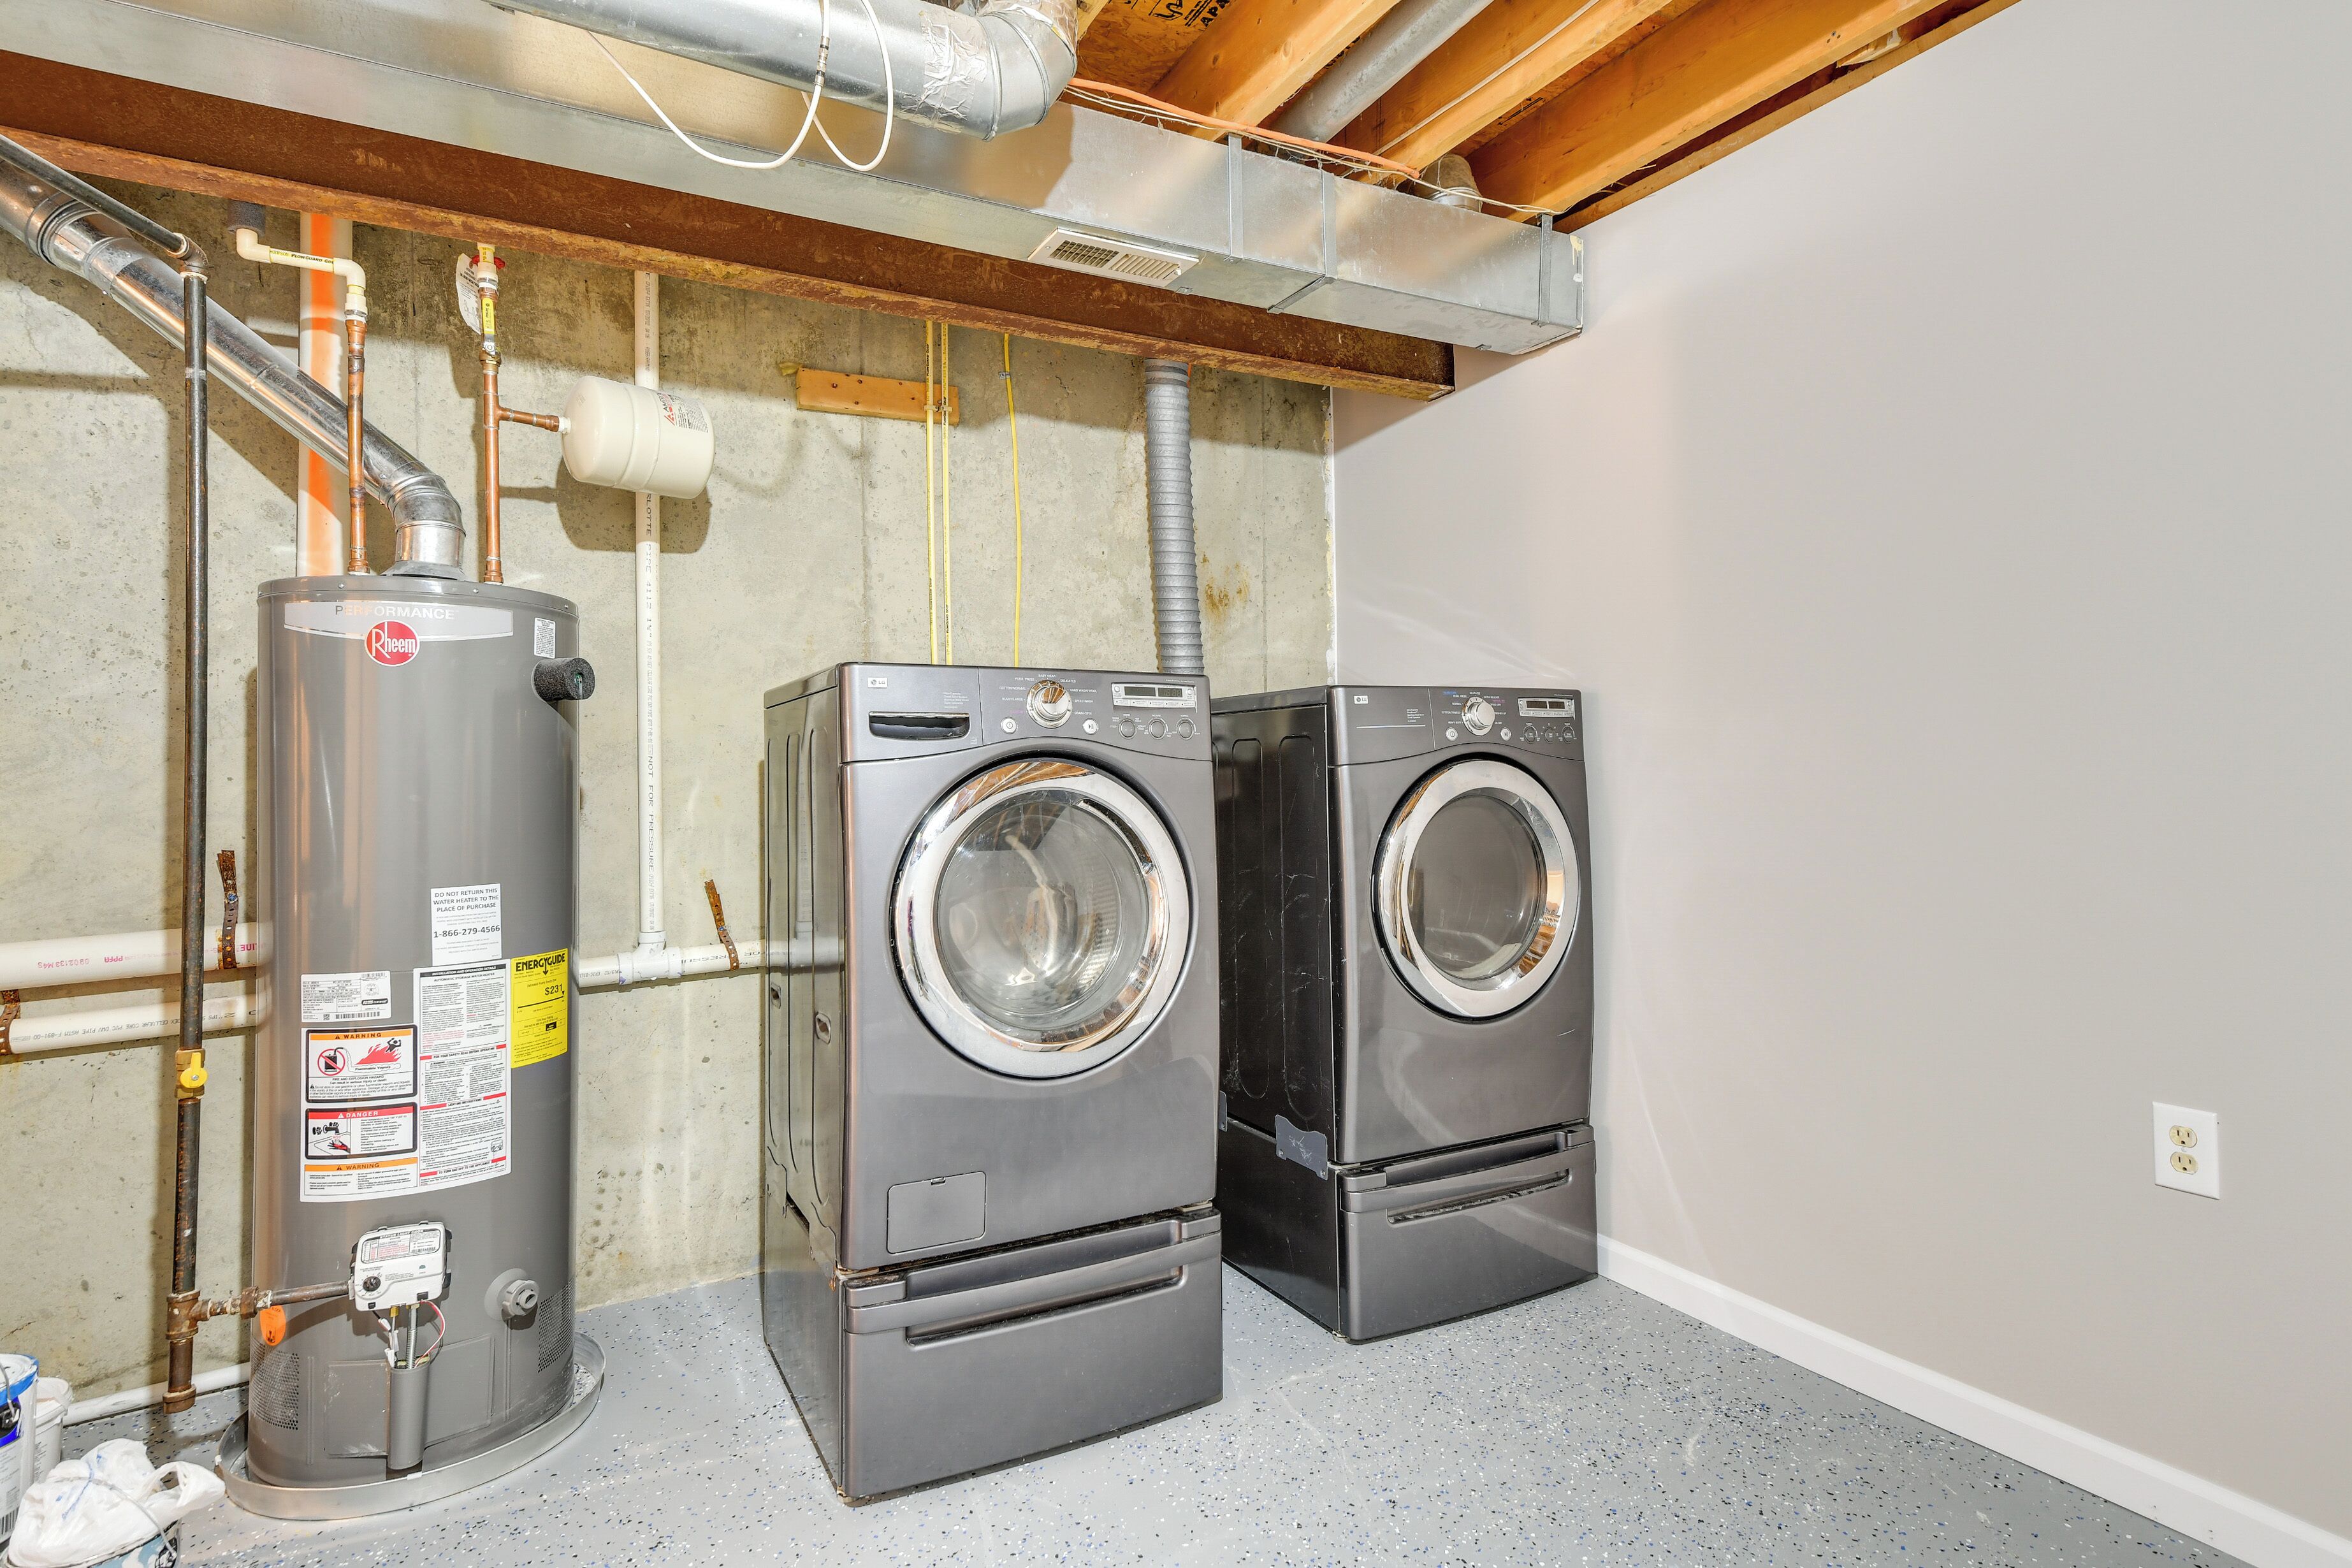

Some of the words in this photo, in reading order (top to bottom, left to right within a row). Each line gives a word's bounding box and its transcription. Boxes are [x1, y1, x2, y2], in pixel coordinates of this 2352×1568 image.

[291, 254, 322, 262] FLOWGUARD
[335, 605, 454, 620] PERFORMANCE
[372, 621, 416, 658] Rheem
[433, 925, 500, 938] 1-866-279-4566
[516, 953, 565, 973] ENERGYGUIDE
[544, 984, 562, 996] $231
